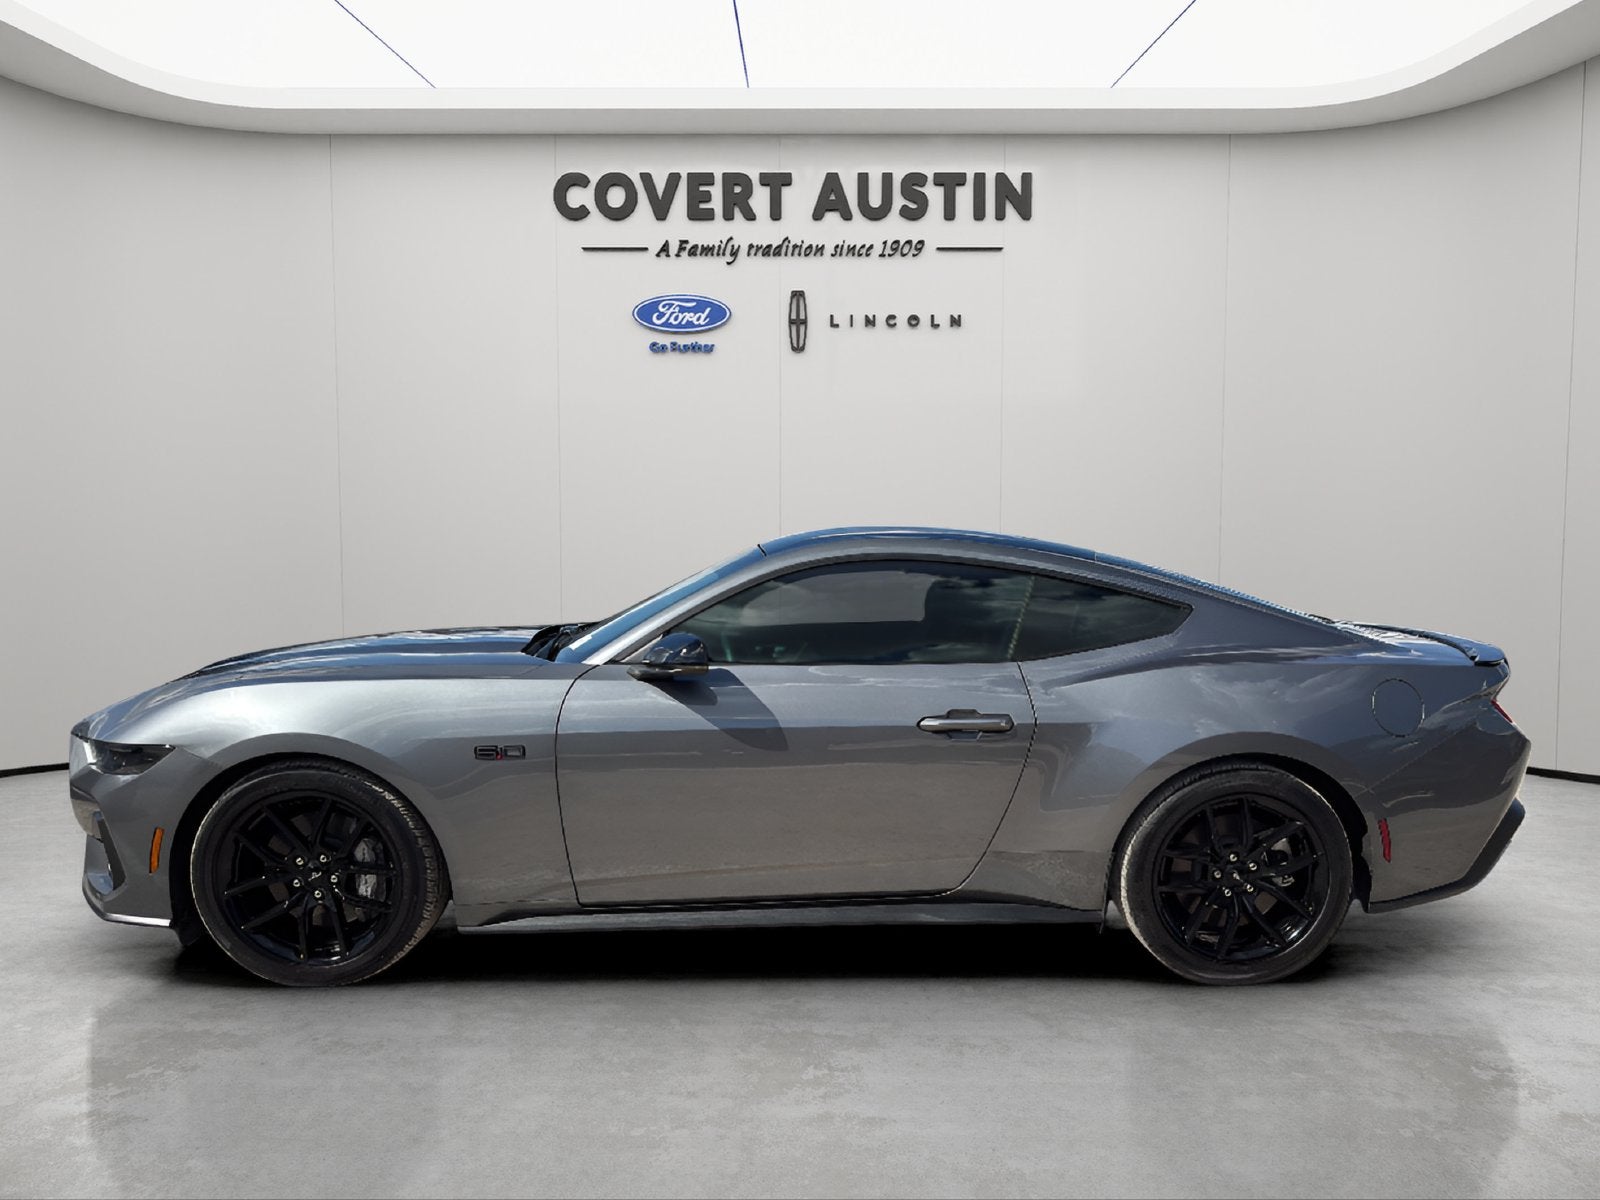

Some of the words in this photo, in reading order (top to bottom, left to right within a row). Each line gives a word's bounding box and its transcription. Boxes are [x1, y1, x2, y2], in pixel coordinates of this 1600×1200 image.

[553, 172, 793, 222] COVERT
[812, 172, 1033, 222] AUSTIN
[655, 239, 672, 258] A
[675, 236, 741, 266] Family
[746, 236, 826, 258] tradition
[830, 240, 874, 258] since
[878, 239, 926, 258] 1909
[652, 300, 712, 325] Ford
[829, 314, 963, 329] LINCOLN
